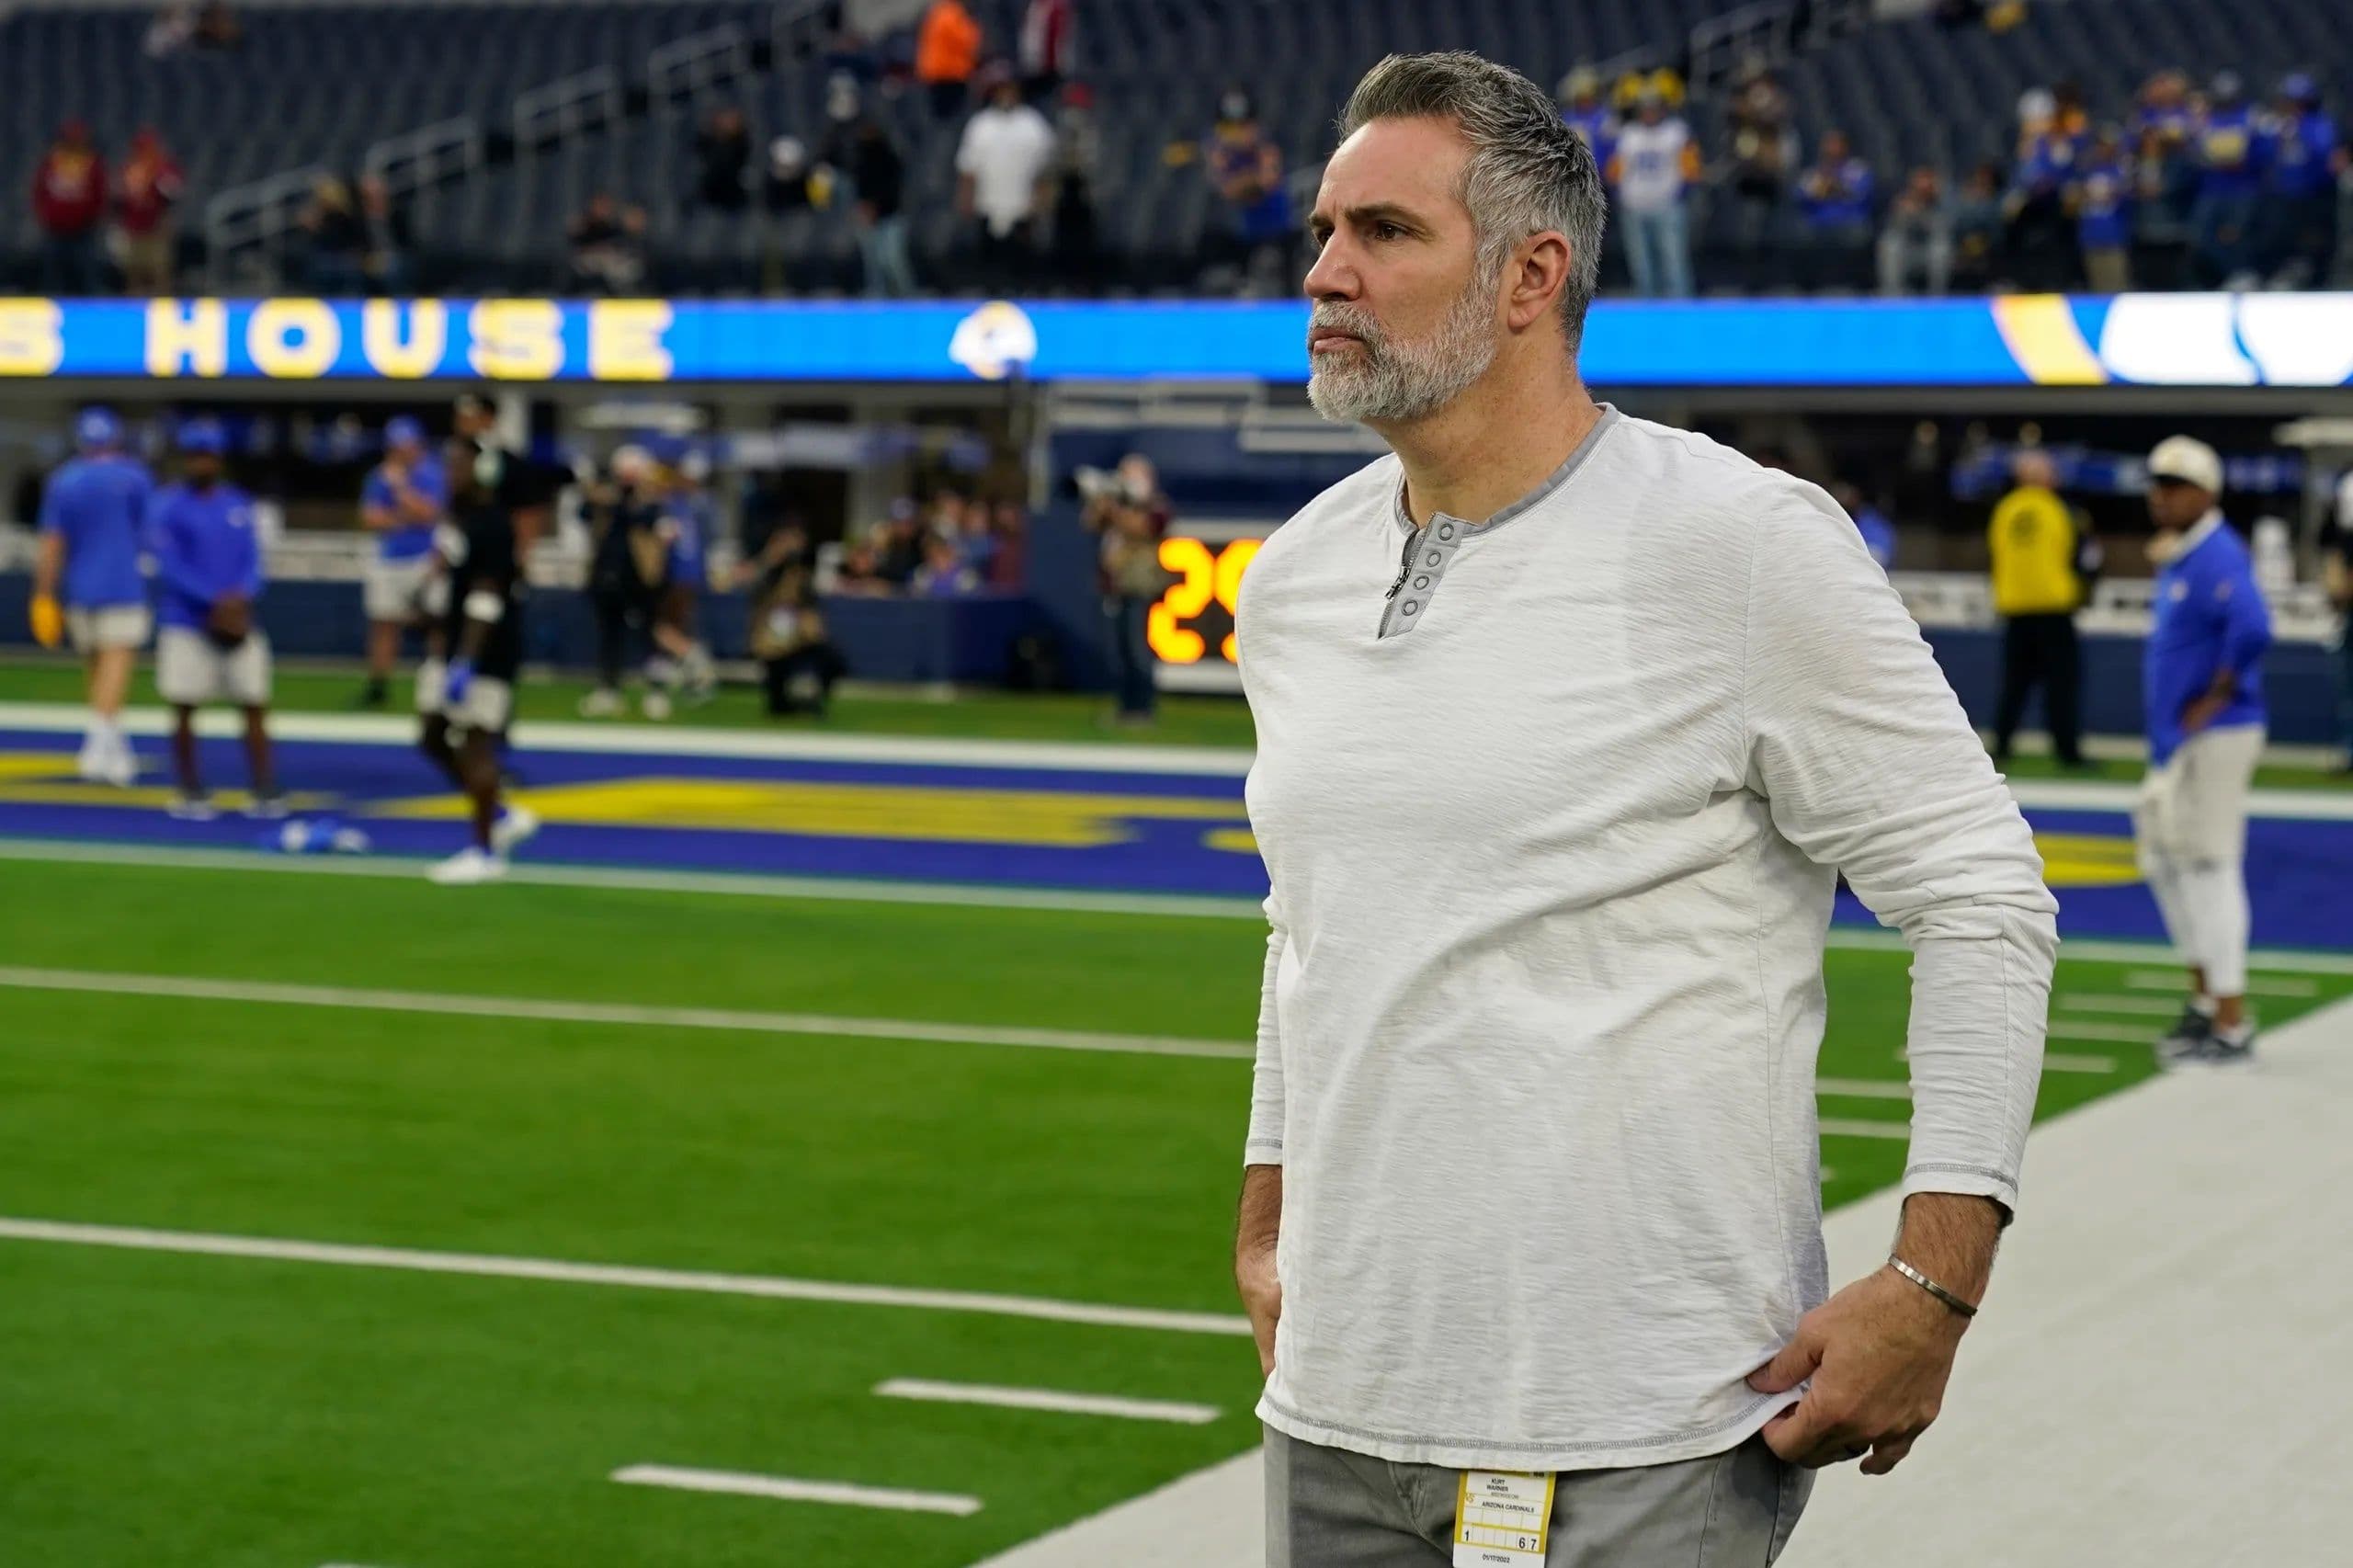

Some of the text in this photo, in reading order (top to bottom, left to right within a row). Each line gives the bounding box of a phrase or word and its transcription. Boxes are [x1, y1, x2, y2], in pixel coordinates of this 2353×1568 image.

[0, 296, 675, 381] S HOUSE
[1482, 1501, 1534, 1513] ARIZONA CARDINALS
[1465, 1530, 1537, 1550] 1 6 7
